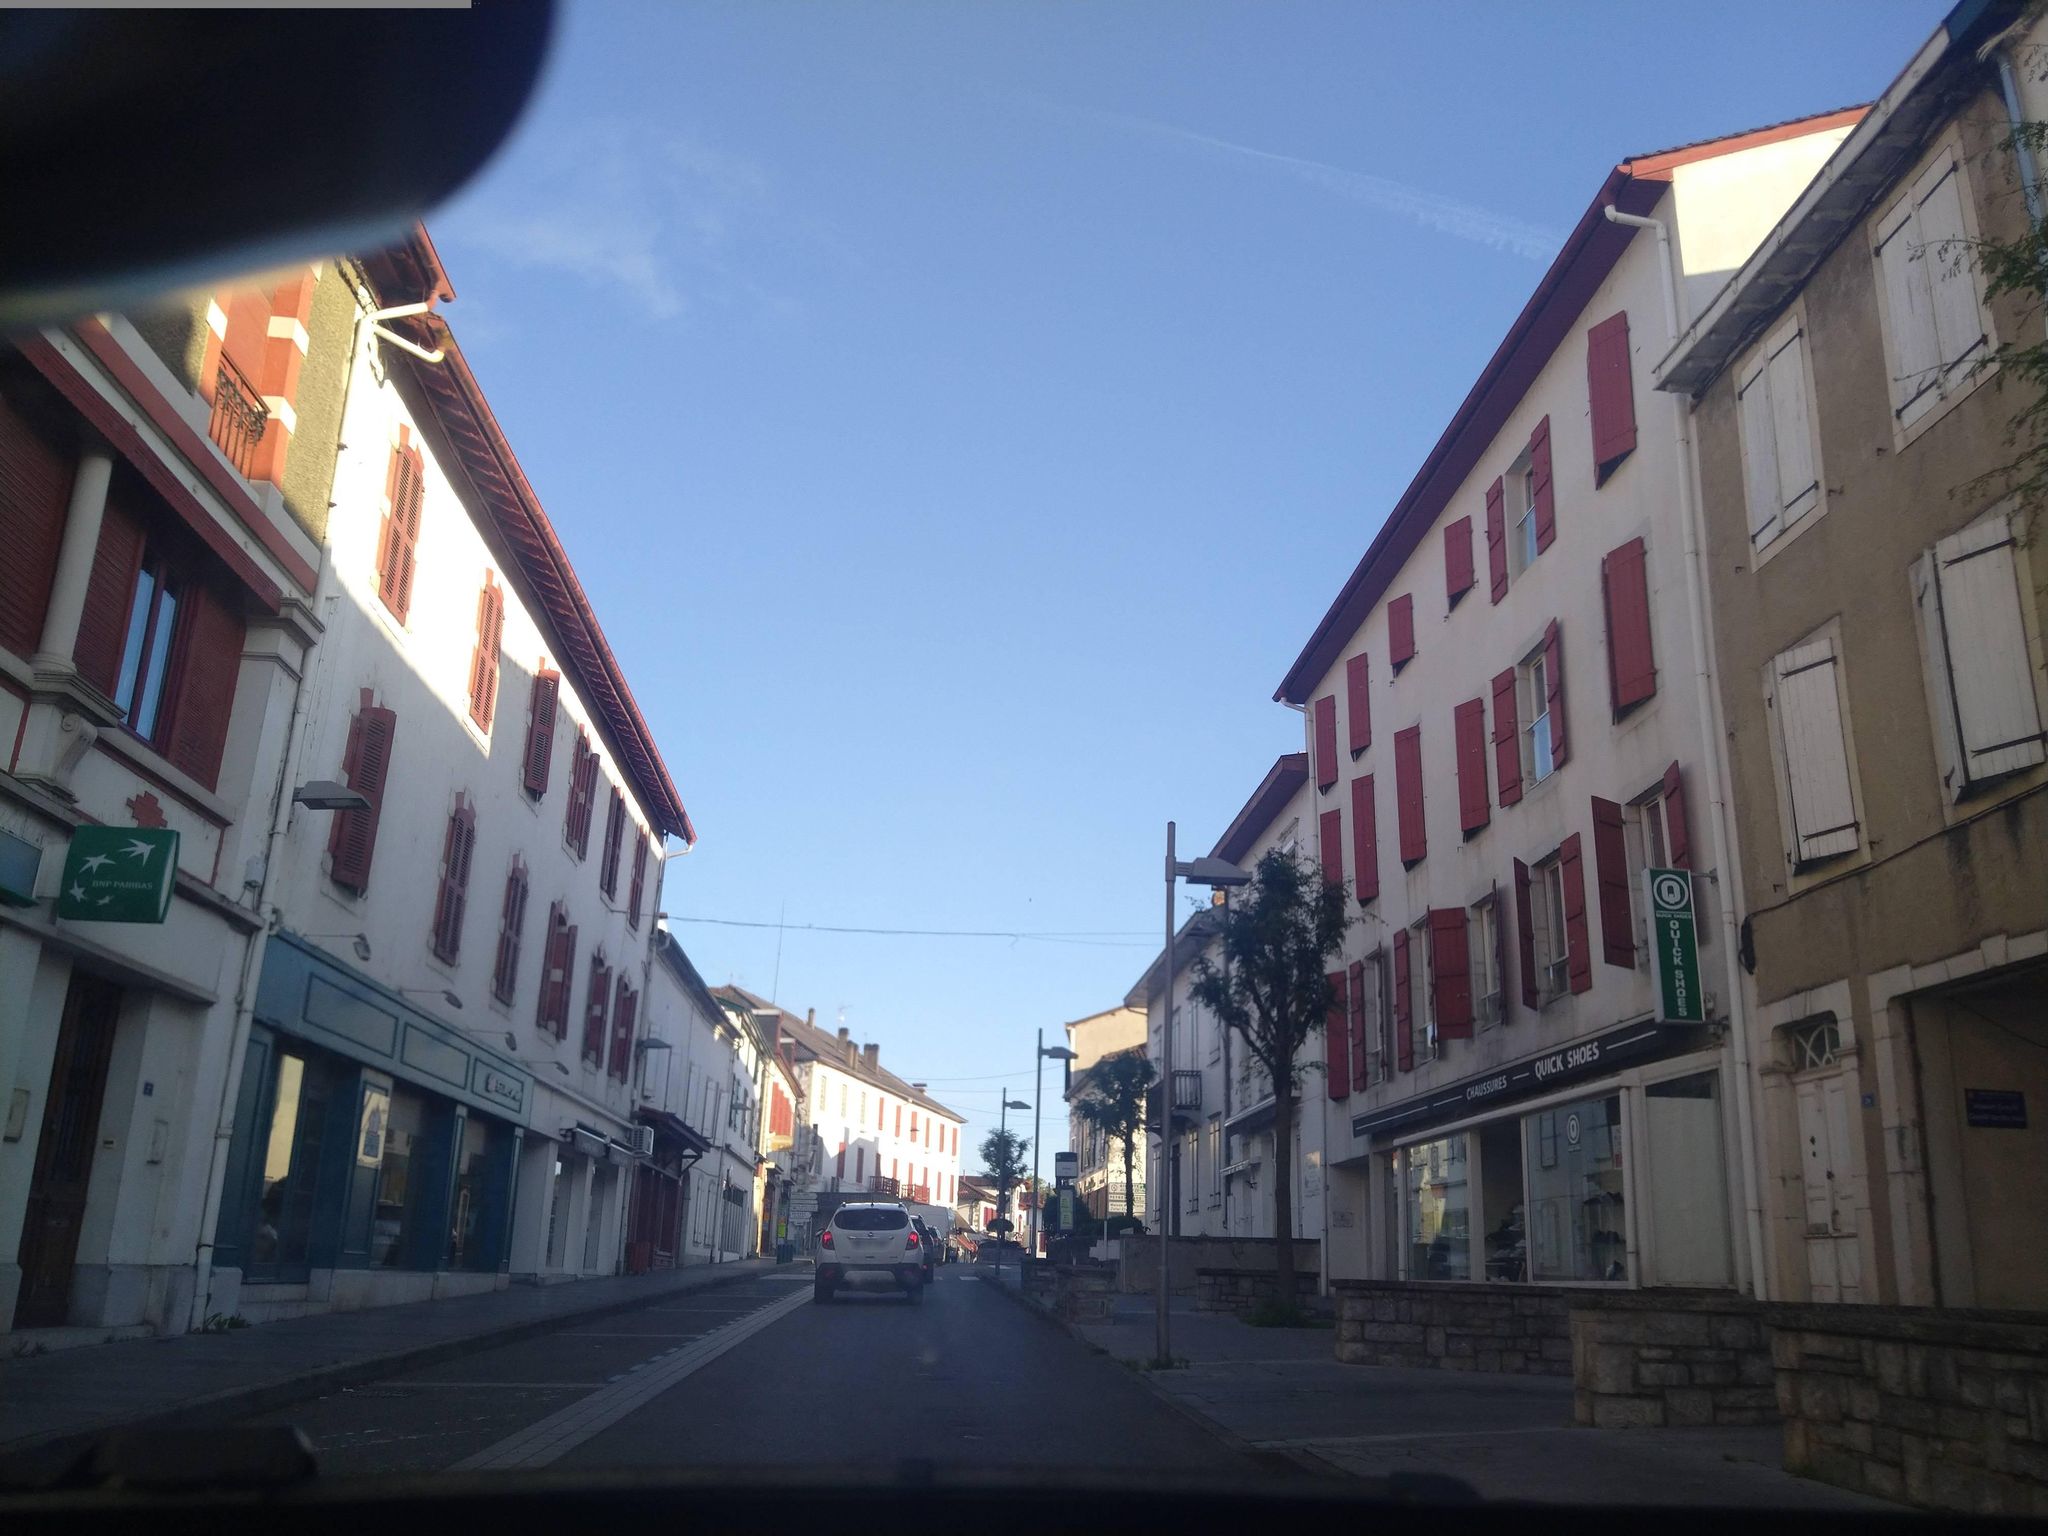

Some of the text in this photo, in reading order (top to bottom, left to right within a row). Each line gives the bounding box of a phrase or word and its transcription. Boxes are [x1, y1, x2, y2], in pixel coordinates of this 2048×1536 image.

[91, 880, 112, 888] BNP
[1669, 920, 1688, 1017] QUICK SHOES
[1466, 1041, 1600, 1100] CHAUSSURES QUICK SHOES
